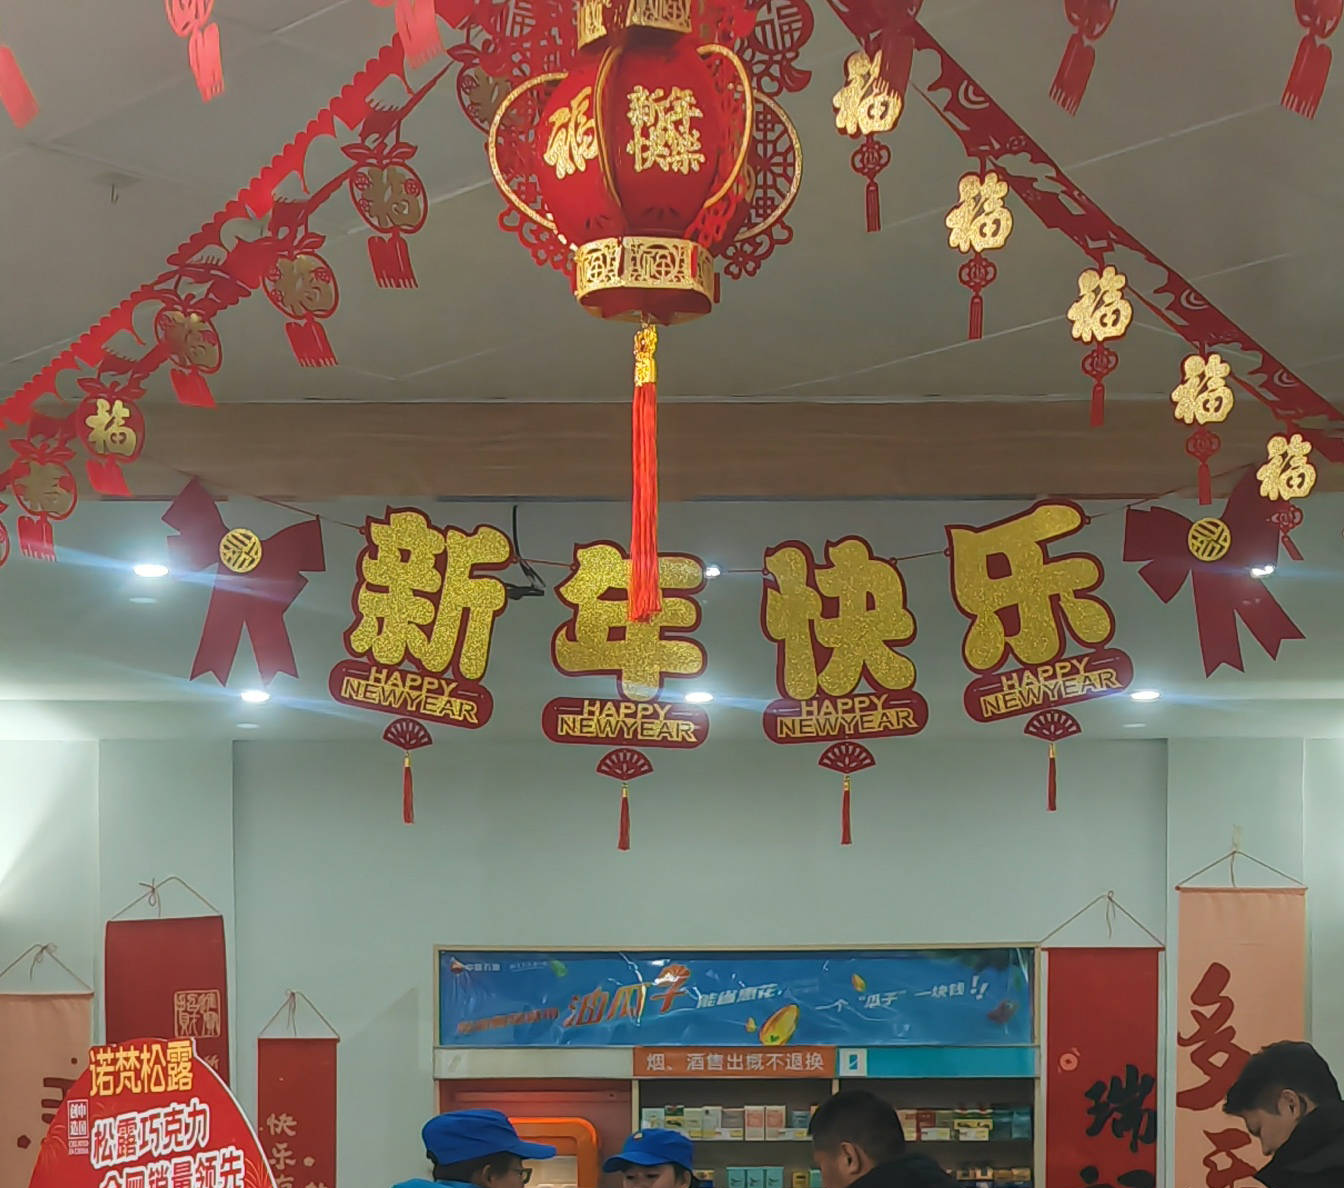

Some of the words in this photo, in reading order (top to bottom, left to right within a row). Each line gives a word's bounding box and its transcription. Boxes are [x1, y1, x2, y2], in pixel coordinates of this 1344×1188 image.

[946, 172, 1014, 253] 福
[1067, 266, 1134, 342] 福
[1171, 354, 1235, 425] 福
[84, 398, 138, 457] 福
[1257, 434, 1316, 500] 福
[368, 666, 458, 697] HAPPY
[1013, 657, 1091, 693] HAPPY
[582, 700, 672, 722] HAPPY
[800, 694, 891, 721] HAPPY
[89, 1041, 193, 1097] 诺梵松露
[92, 1099, 210, 1168] 松露巧克力
